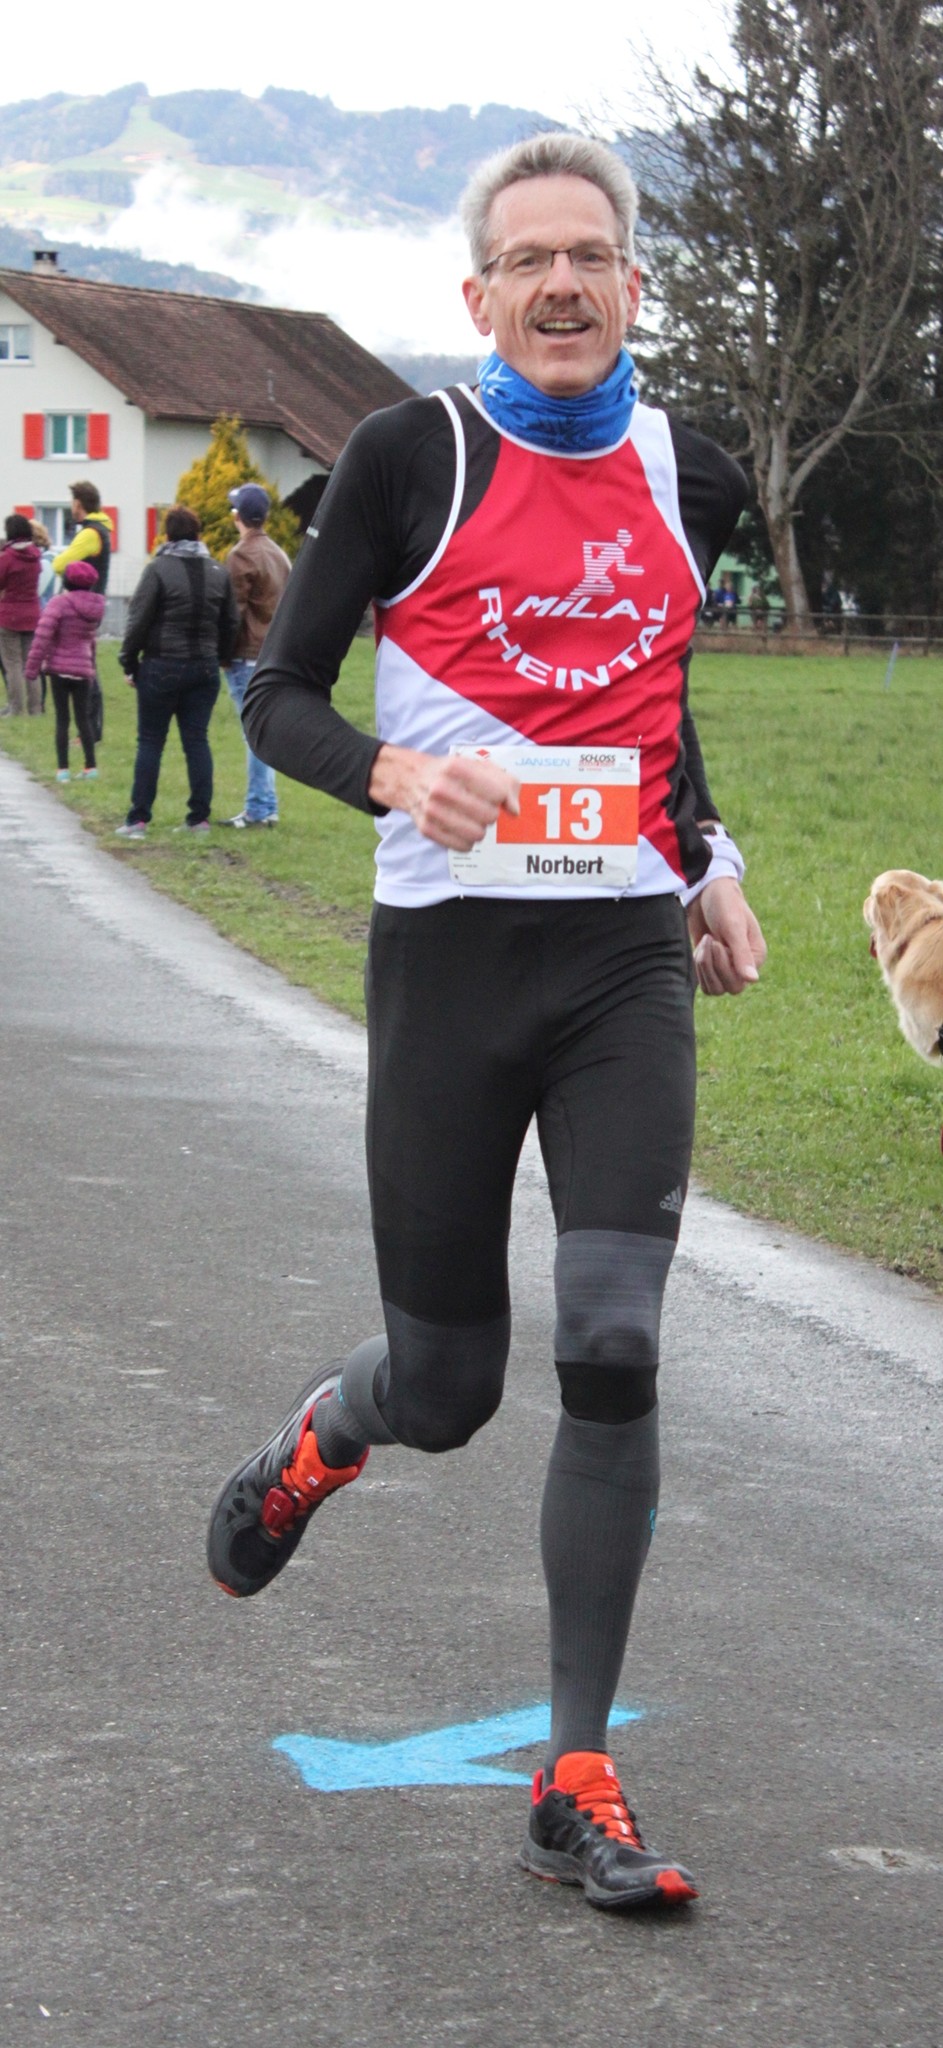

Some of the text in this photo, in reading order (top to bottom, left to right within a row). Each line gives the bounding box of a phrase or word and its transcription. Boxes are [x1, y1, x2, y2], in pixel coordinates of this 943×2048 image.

[478, 587, 669, 691] RHEINTAL
[515, 758, 570, 767] JANSEN
[580, 754, 616, 763] SCHLOSS
[537, 787, 603, 840] 13
[526, 855, 604, 874] Norbert
